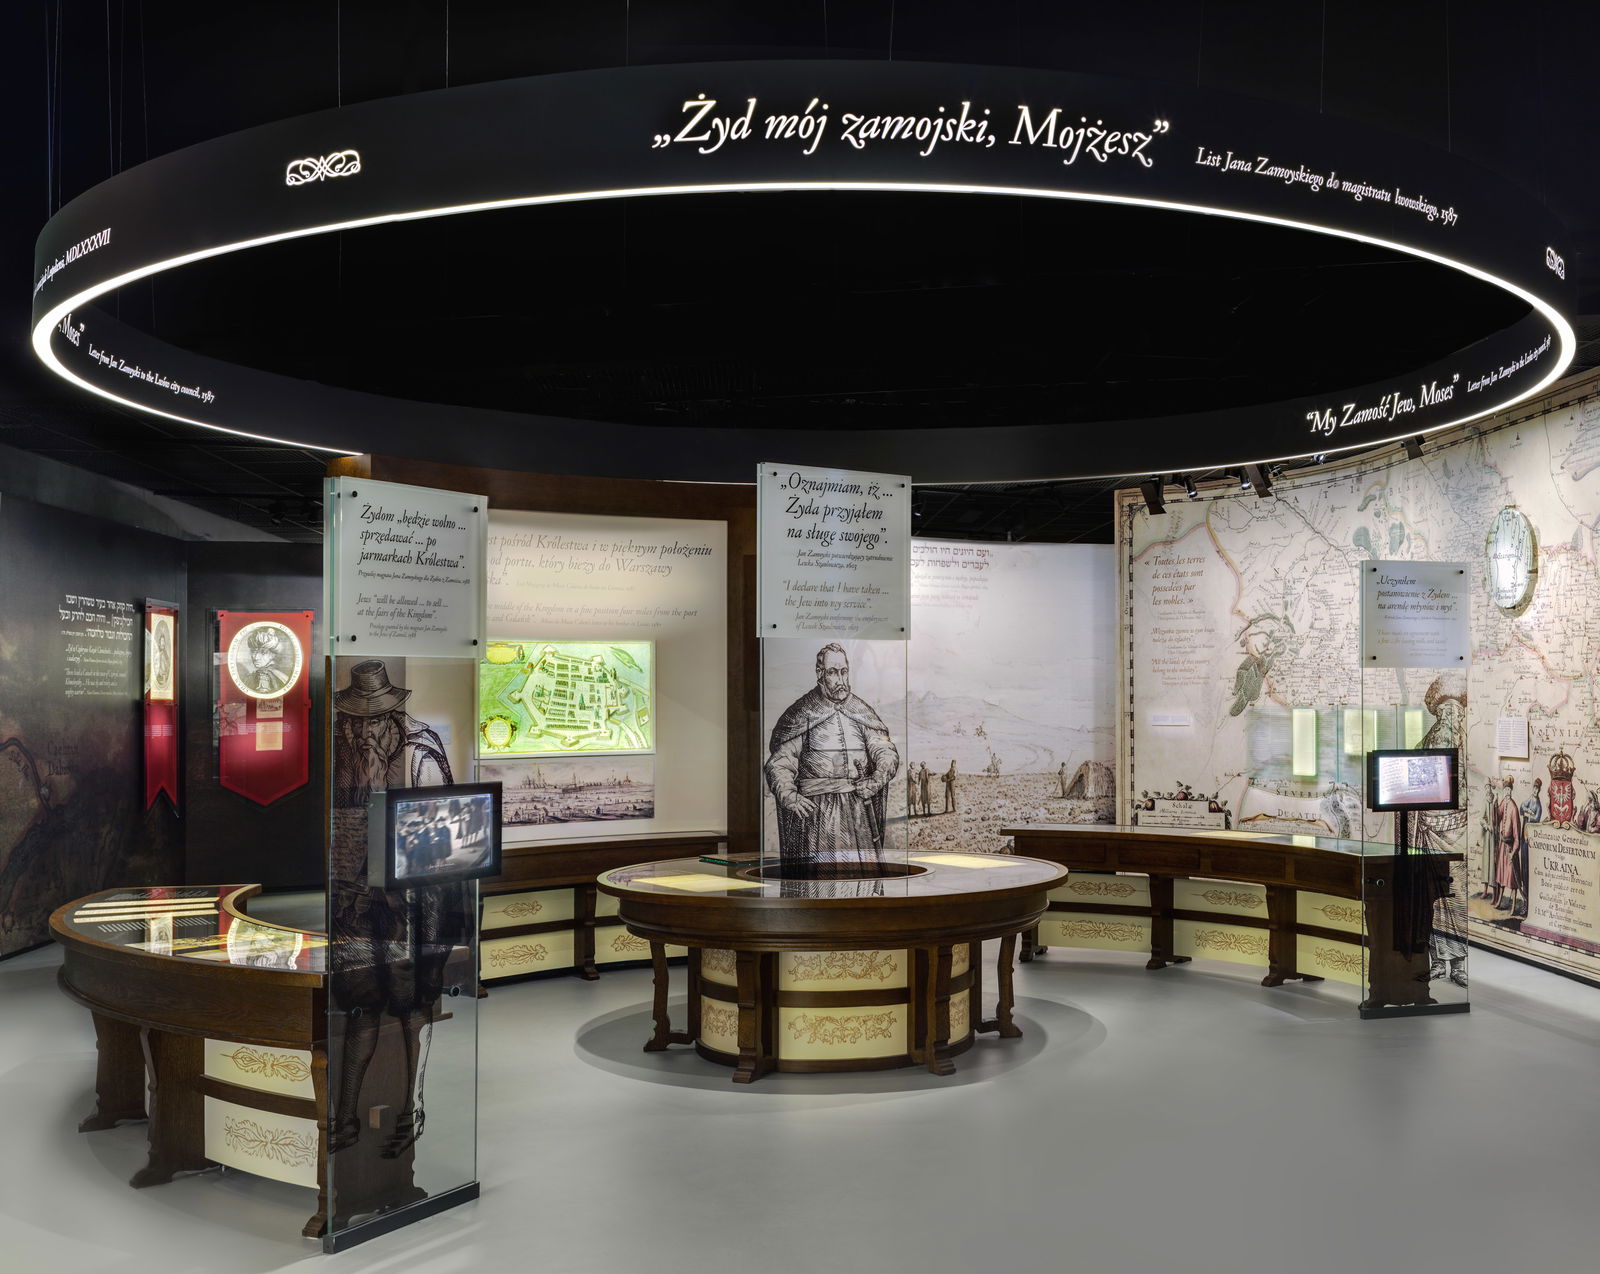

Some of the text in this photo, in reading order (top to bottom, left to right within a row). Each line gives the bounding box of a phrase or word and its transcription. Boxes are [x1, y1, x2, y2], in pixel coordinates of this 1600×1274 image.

[652, 92, 1170, 168] „Żyd mój zamojski, Mojżesz”
[1195, 147, 1459, 226] List Jana Zamoyskiego do magistratu lwowskiego, 1587
[66, 228, 112, 266] MDLXXXVII
[201, 391, 215, 404] 1587
[1306, 374, 1460, 436] “My Zamość Jew, Moses”
[780, 472, 880, 500] „Oznajmiam, iż
[360, 502, 456, 528] Żydom „będzie wolno
[786, 494, 883, 524] Żyda przyjąłem
[360, 528, 437, 551] sprzedawać po
[500, 534, 713, 559] pośród Królestwa i w pięknym położeniu
[786, 523, 888, 550] na sługę swojego”.
[357, 548, 465, 569] jarmarkach Królestwa”.
[490, 554, 502, 566] od
[539, 554, 565, 573] który
[568, 559, 596, 574] bieży
[599, 560, 611, 572] do
[616, 558, 673, 577] Warszawy
[1176, 554, 1185, 564] les
[1152, 570, 1160, 579] de
[1173, 569, 1188, 578] états
[792, 580, 817, 592] declare
[819, 581, 834, 592] that
[836, 582, 841, 592] I
[843, 582, 860, 593] have
[861, 584, 881, 595] taken
[1183, 584, 1196, 595] par
[389, 595, 395, 605] be
[396, 596, 418, 606] allowed
[432, 598, 442, 607] sell
[785, 595, 796, 606] the
[796, 595, 813, 608] Jew
[814, 597, 828, 607] into
[830, 601, 842, 611] my
[1153, 596, 1161, 605] les
[365, 606, 375, 617] the
[375, 606, 388, 619] fairs
[390, 607, 398, 620] of
[397, 608, 406, 618] the
[672, 608, 682, 617] the
[682, 610, 698, 620] port
